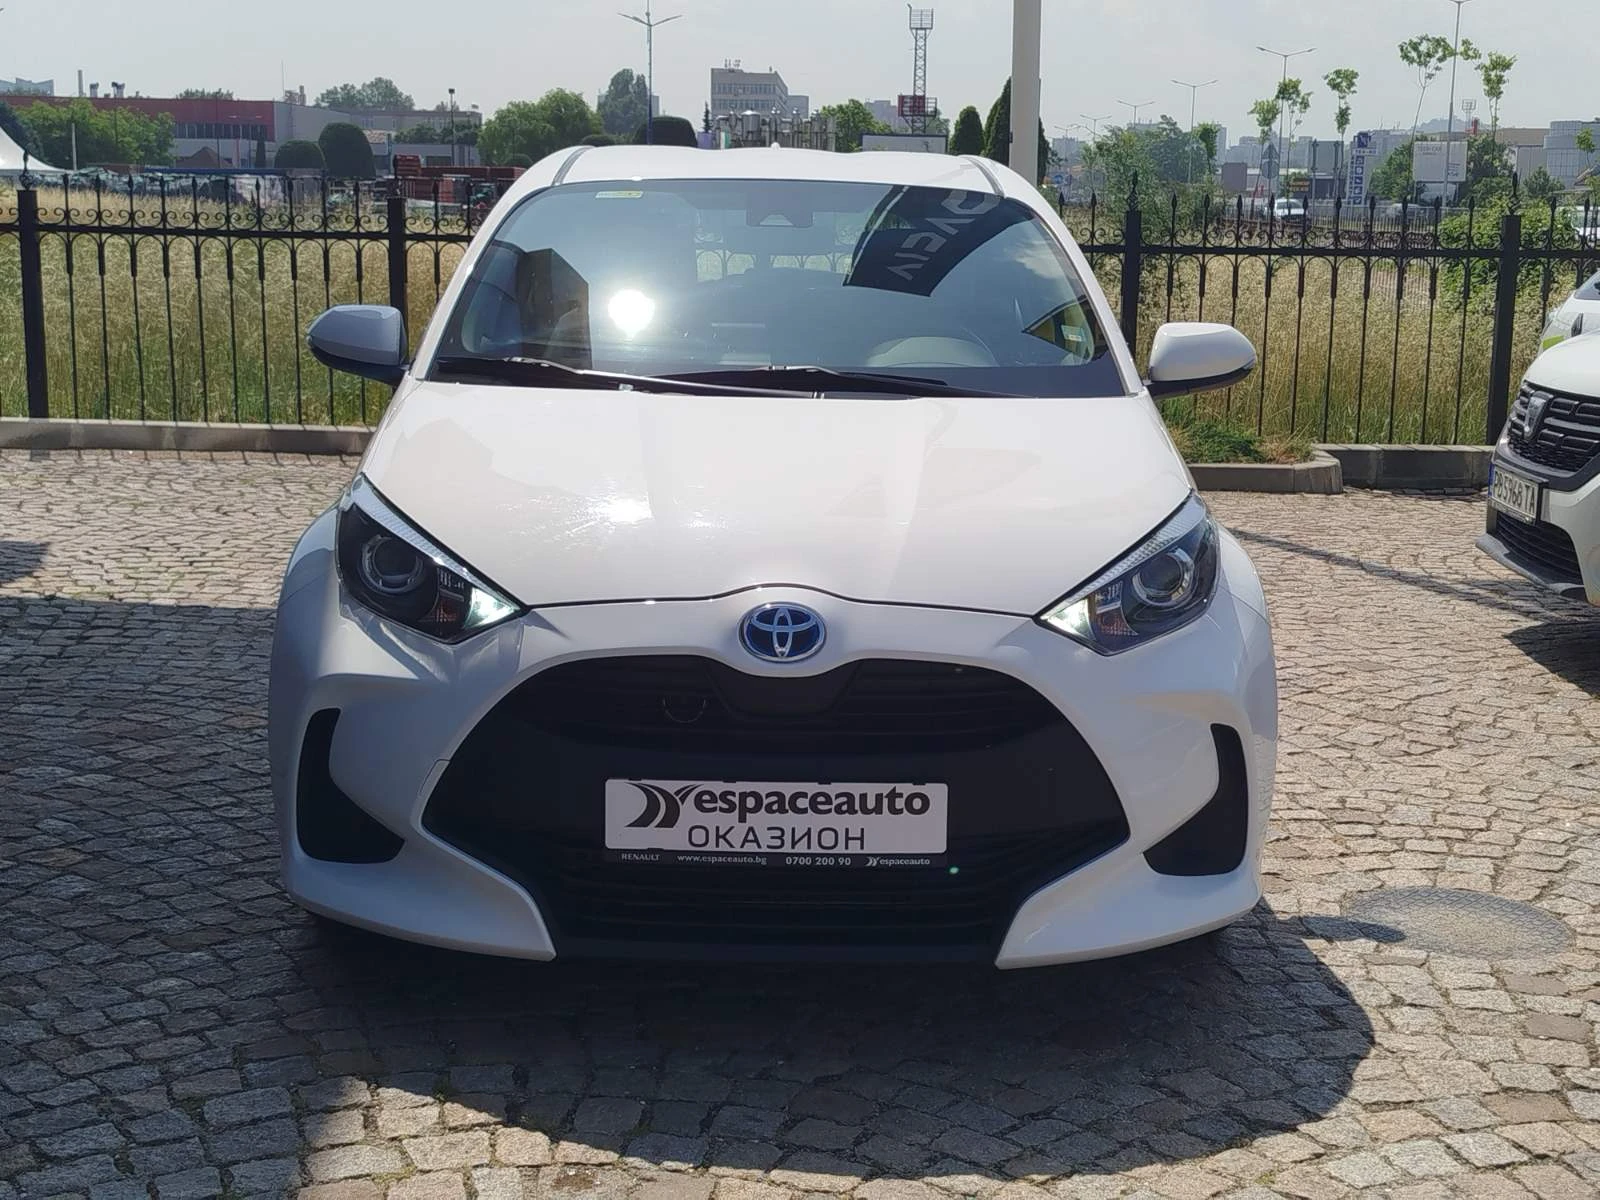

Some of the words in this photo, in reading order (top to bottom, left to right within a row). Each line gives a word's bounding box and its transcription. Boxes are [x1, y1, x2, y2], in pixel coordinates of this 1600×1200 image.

[694, 785, 930, 823] espaceauto
[687, 824, 865, 850] ОКАЗИОН
[621, 852, 660, 862] RENAULT
[677, 853, 767, 866] www.espaceauto.bg
[785, 856, 813, 866] 0700
[815, 856, 835, 867] 200
[838, 857, 851, 867] 90
[879, 857, 930, 868] espaceauto
